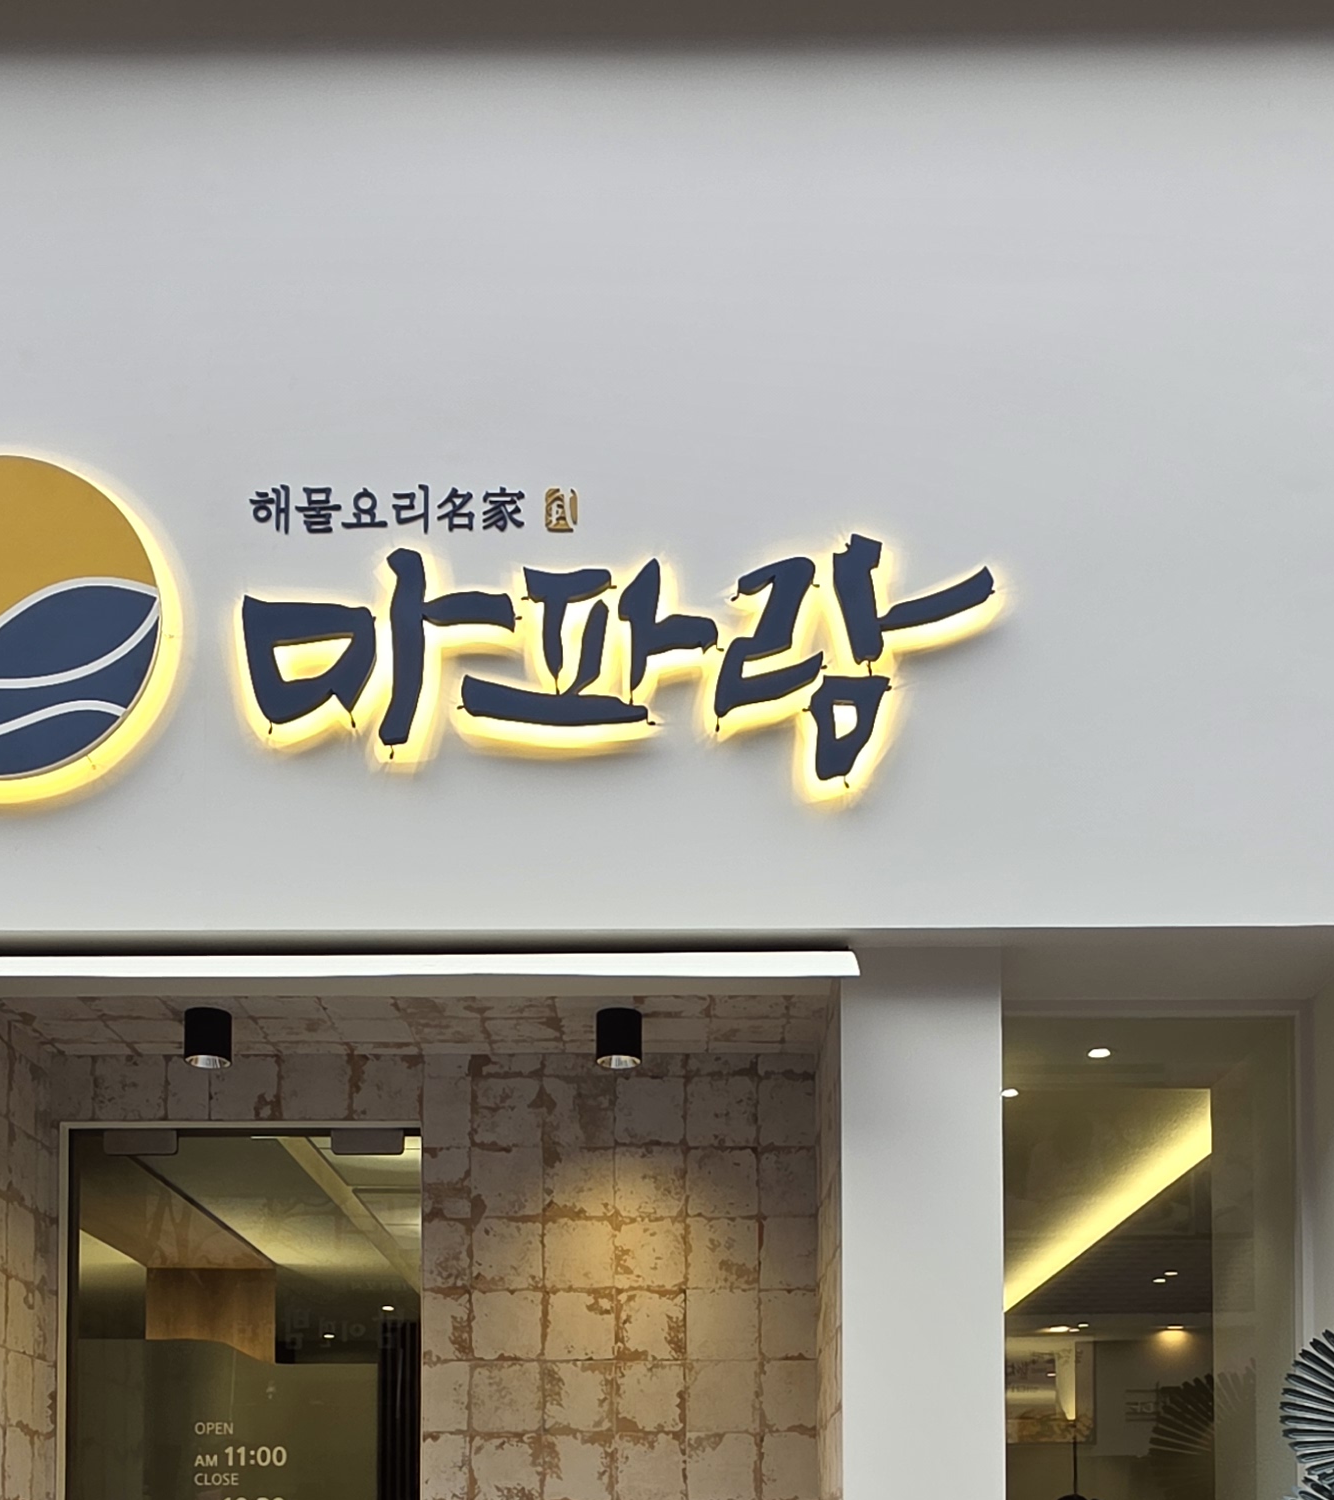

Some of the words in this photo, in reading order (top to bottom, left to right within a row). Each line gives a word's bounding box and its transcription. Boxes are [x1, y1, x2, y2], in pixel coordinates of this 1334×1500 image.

[249, 484, 526, 535] 해물요리名家
[241, 534, 995, 784] 마파람
[194, 1421, 234, 1435] OPEN
[194, 1454, 218, 1467] AM
[224, 1445, 287, 1467] 11:00
[194, 1472, 239, 1486] CLOSE
